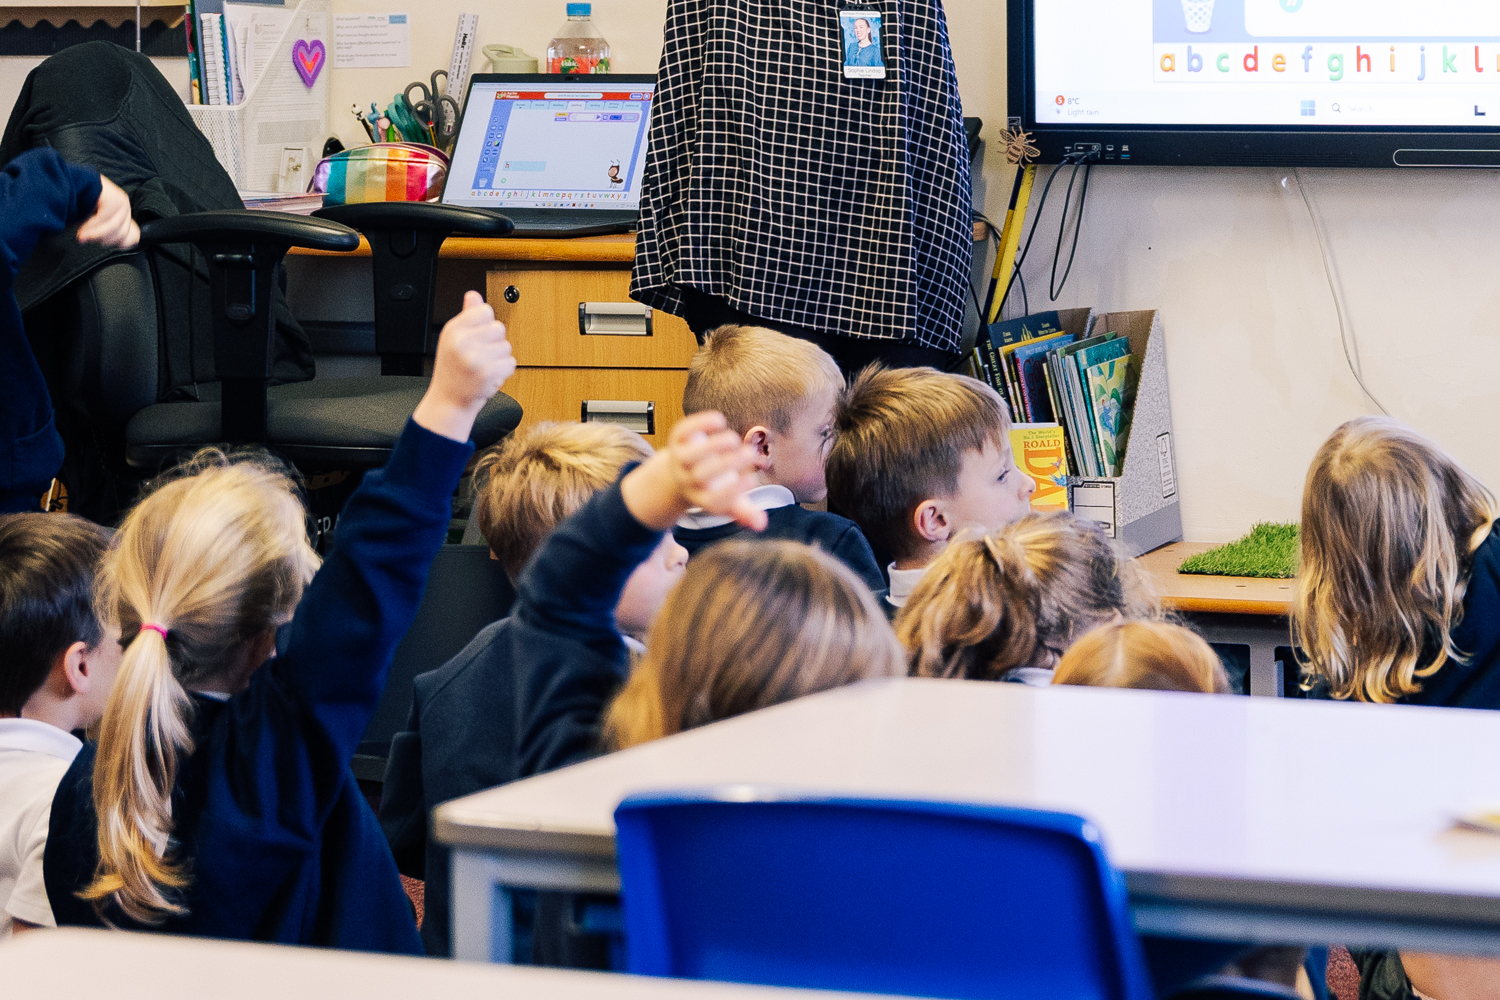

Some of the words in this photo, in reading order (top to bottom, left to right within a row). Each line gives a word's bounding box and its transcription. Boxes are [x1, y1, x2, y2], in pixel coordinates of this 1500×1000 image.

[1161, 54, 1175, 72] a
[1187, 46, 1203, 72] b
[1216, 53, 1230, 72] c
[1243, 46, 1258, 72] d
[1272, 53, 1286, 72] e
[1302, 46, 1313, 72] f
[1327, 53, 1344, 81] g
[1356, 46, 1371, 72] h
[1390, 46, 1395, 72] i
[1417, 46, 1426, 81] j
[1442, 46, 1458, 72] k
[1474, 46, 1484, 73] l
[1067, 97, 1080, 105] 8°C
[1067, 107, 1084, 117] Light
[1085, 108, 1099, 116] rain
[1023, 439, 1061, 449] ROALD
